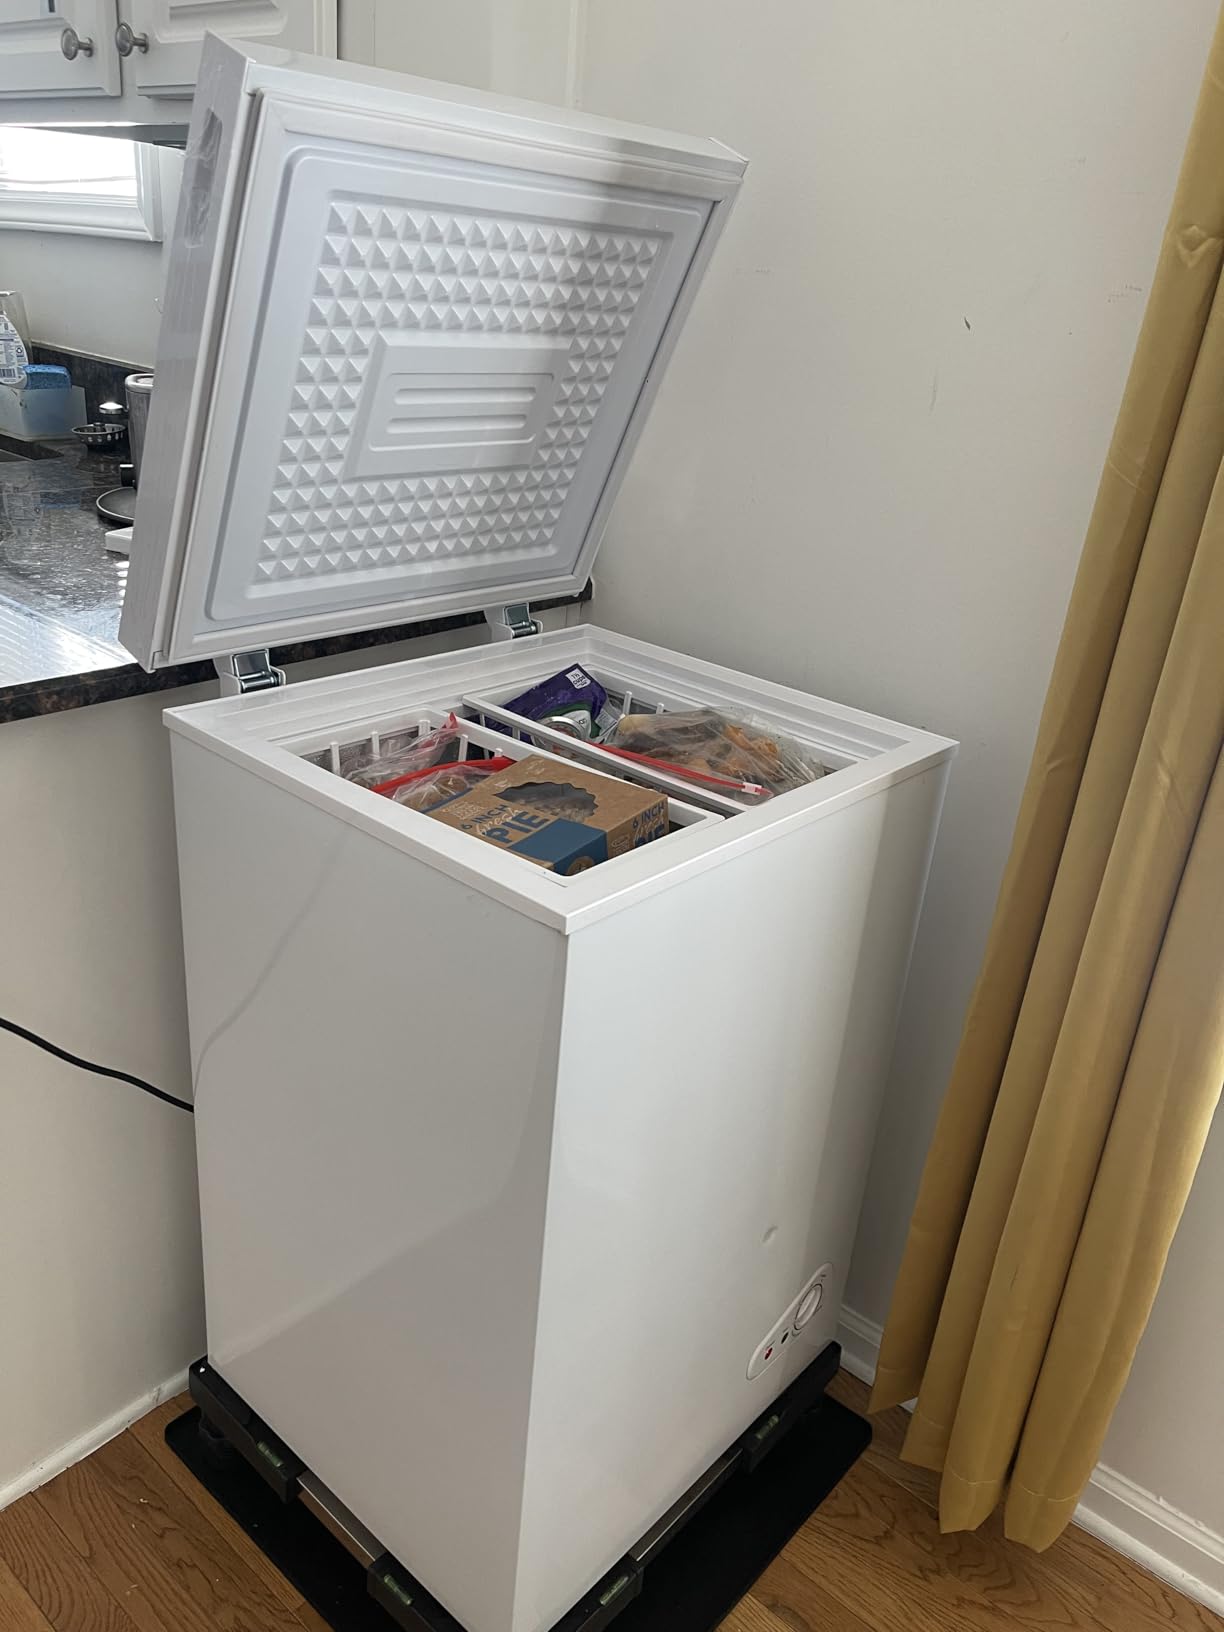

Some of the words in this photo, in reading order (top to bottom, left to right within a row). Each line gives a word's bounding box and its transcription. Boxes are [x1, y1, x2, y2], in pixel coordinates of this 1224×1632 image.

[471, 804, 510, 824] INCH
[641, 801, 664, 822] INCH
[481, 811, 550, 843] PIE
